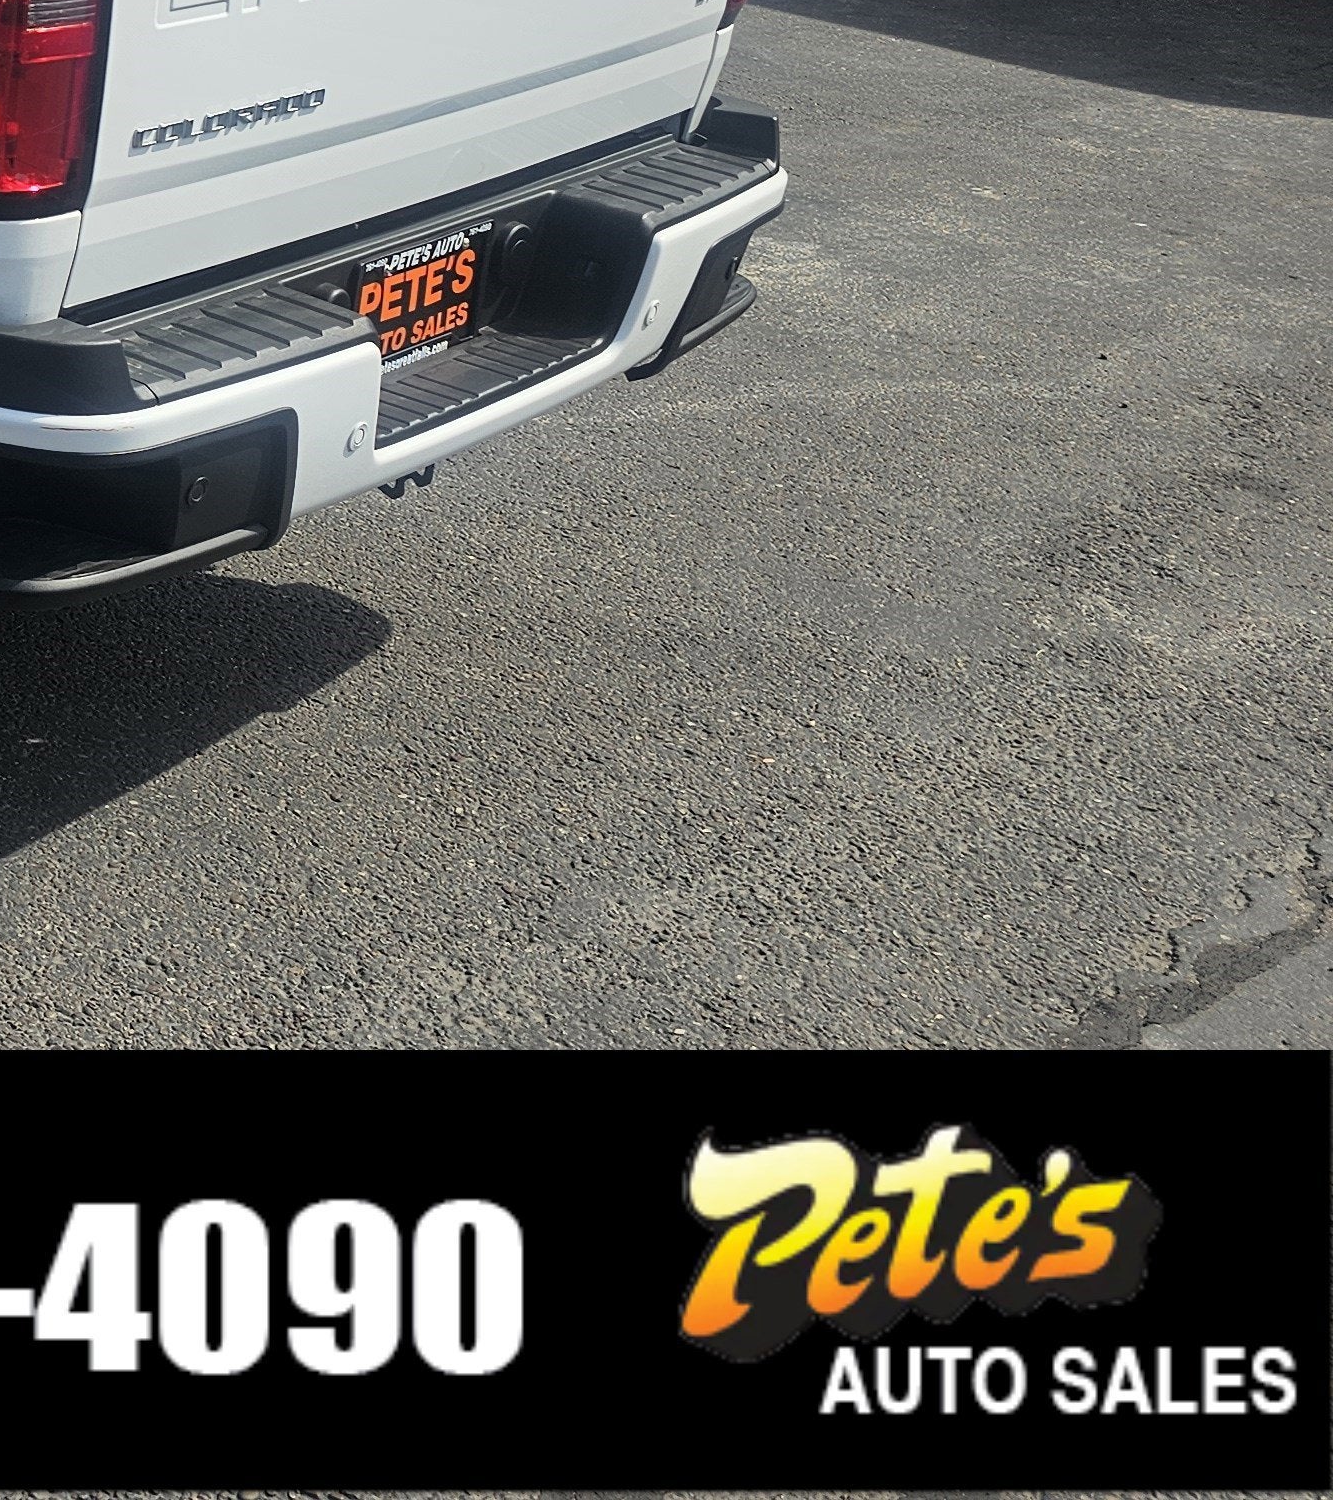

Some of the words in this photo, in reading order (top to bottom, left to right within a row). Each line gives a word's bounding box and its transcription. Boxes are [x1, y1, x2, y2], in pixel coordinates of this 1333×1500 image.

[130, 87, 326, 150] COLORADO
[388, 243, 433, 271] PETE'S
[432, 231, 465, 259] AUTO
[359, 249, 476, 322] PETE'S
[410, 301, 469, 344] SALES
